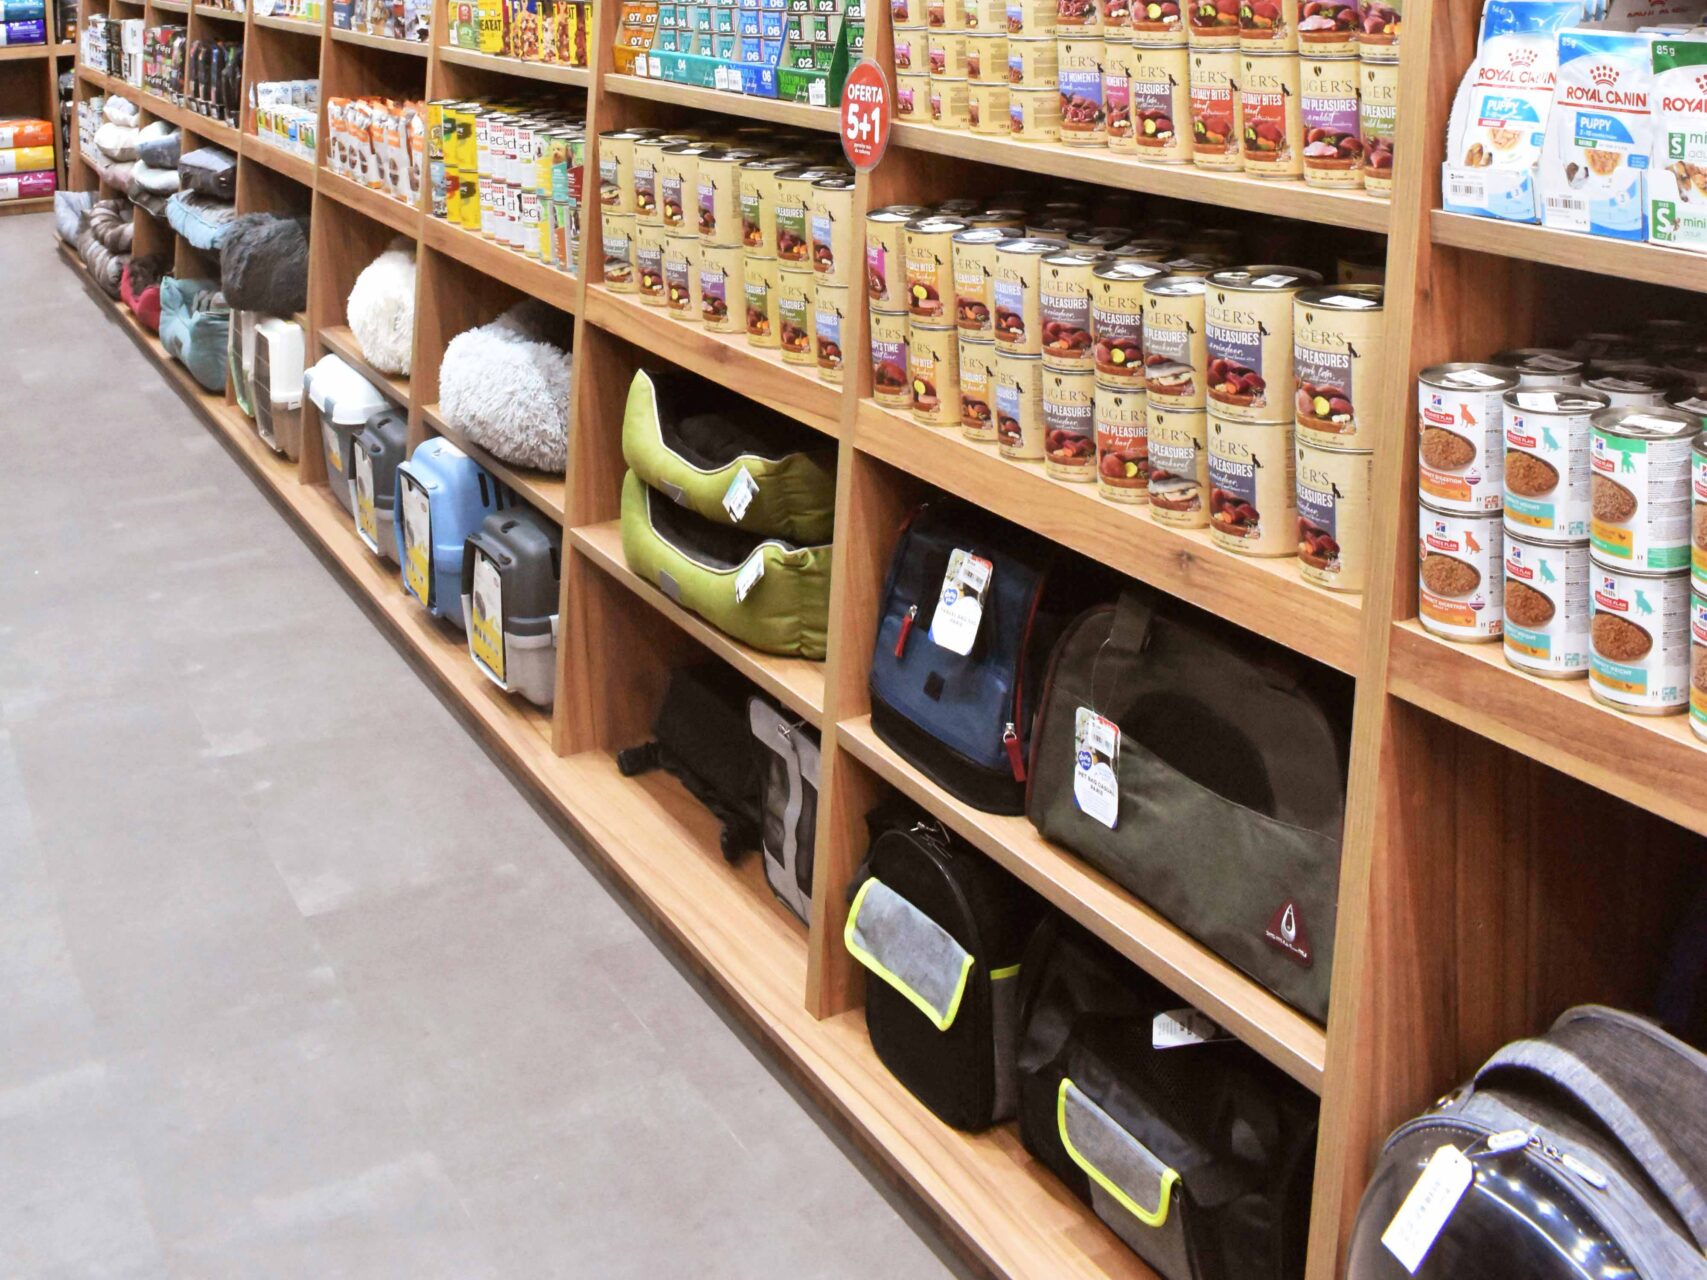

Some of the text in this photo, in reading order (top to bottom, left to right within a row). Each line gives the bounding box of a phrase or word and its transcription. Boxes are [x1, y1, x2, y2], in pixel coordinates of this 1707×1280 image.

[793, 1, 808, 11] 02
[819, 1, 834, 11] 02
[848, 6, 860, 17] 02
[629, 13, 640, 22] 07
[646, 14, 657, 23] 07
[664, 17, 675, 26] 04
[700, 21, 710, 30] 04
[720, 22, 731, 31] 04
[745, 25, 757, 34] 06
[767, 26, 780, 36] 06
[789, 30, 800, 40] 02
[815, 30, 826, 41] 02
[631, 37, 641, 46] 07
[664, 42, 675, 51] 04
[701, 47, 711, 56] 04
[747, 52, 759, 61] 06
[798, 58, 813, 69] 02
[1070, 72, 1100, 83] MOMENTS
[1479, 68, 1514, 83] ROYAL
[847, 83, 883, 105] OFERTA
[1211, 89, 1230, 101] BITES
[1567, 86, 1646, 107] ROYAL CANIN
[1262, 94, 1282, 106] BITES
[1311, 99, 1357, 112] PLEASURES
[1488, 102, 1521, 114] PUPPY
[846, 103, 881, 144] 5+1
[1580, 116, 1611, 131] PUPPY
[1671, 137, 1682, 155] S
[1657, 207, 1675, 235] S
[1683, 218, 1706, 229] mini
[1049, 296, 1089, 310] PLEASURES
[1100, 310, 1141, 325] PLEASURES
[1151, 330, 1188, 343] PLEASURES
[1215, 328, 1260, 346] PLEASURES
[884, 342, 899, 353] TIME
[1302, 349, 1349, 368] PLEASURES
[1052, 404, 1092, 418] PLEASURES
[1110, 425, 1148, 438] PLEASURE
[1154, 445, 1195, 459] PLEASURES
[1213, 459, 1253, 477] PLEASURES
[1613, 600, 1627, 609] PLAN
